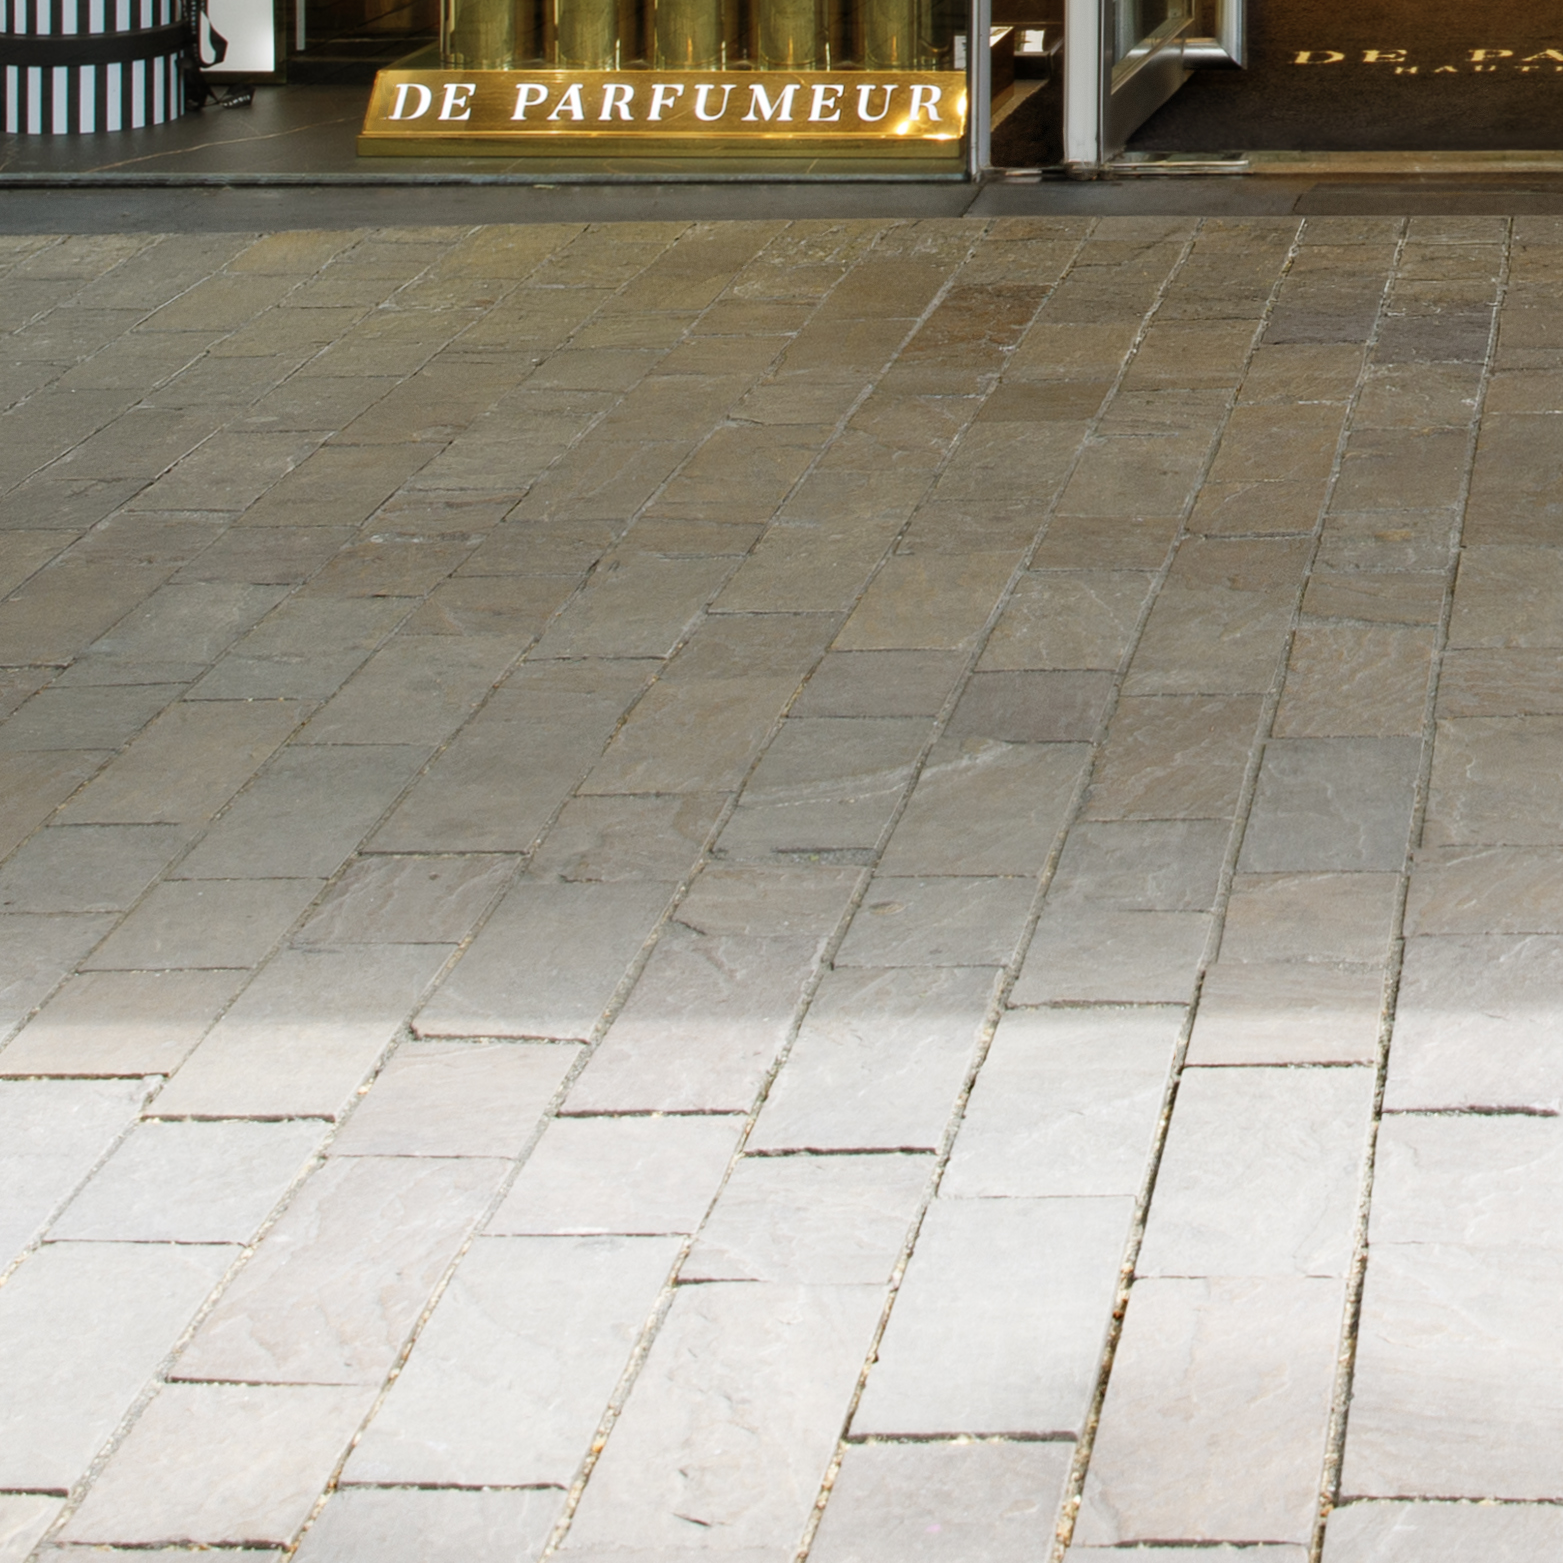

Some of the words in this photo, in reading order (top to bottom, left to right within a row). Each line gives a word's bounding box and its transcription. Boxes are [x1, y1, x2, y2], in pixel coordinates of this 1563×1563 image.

[1288, 49, 1408, 64] DE
[386, 84, 477, 121] DE
[508, 83, 944, 122] PARFUMEUR
